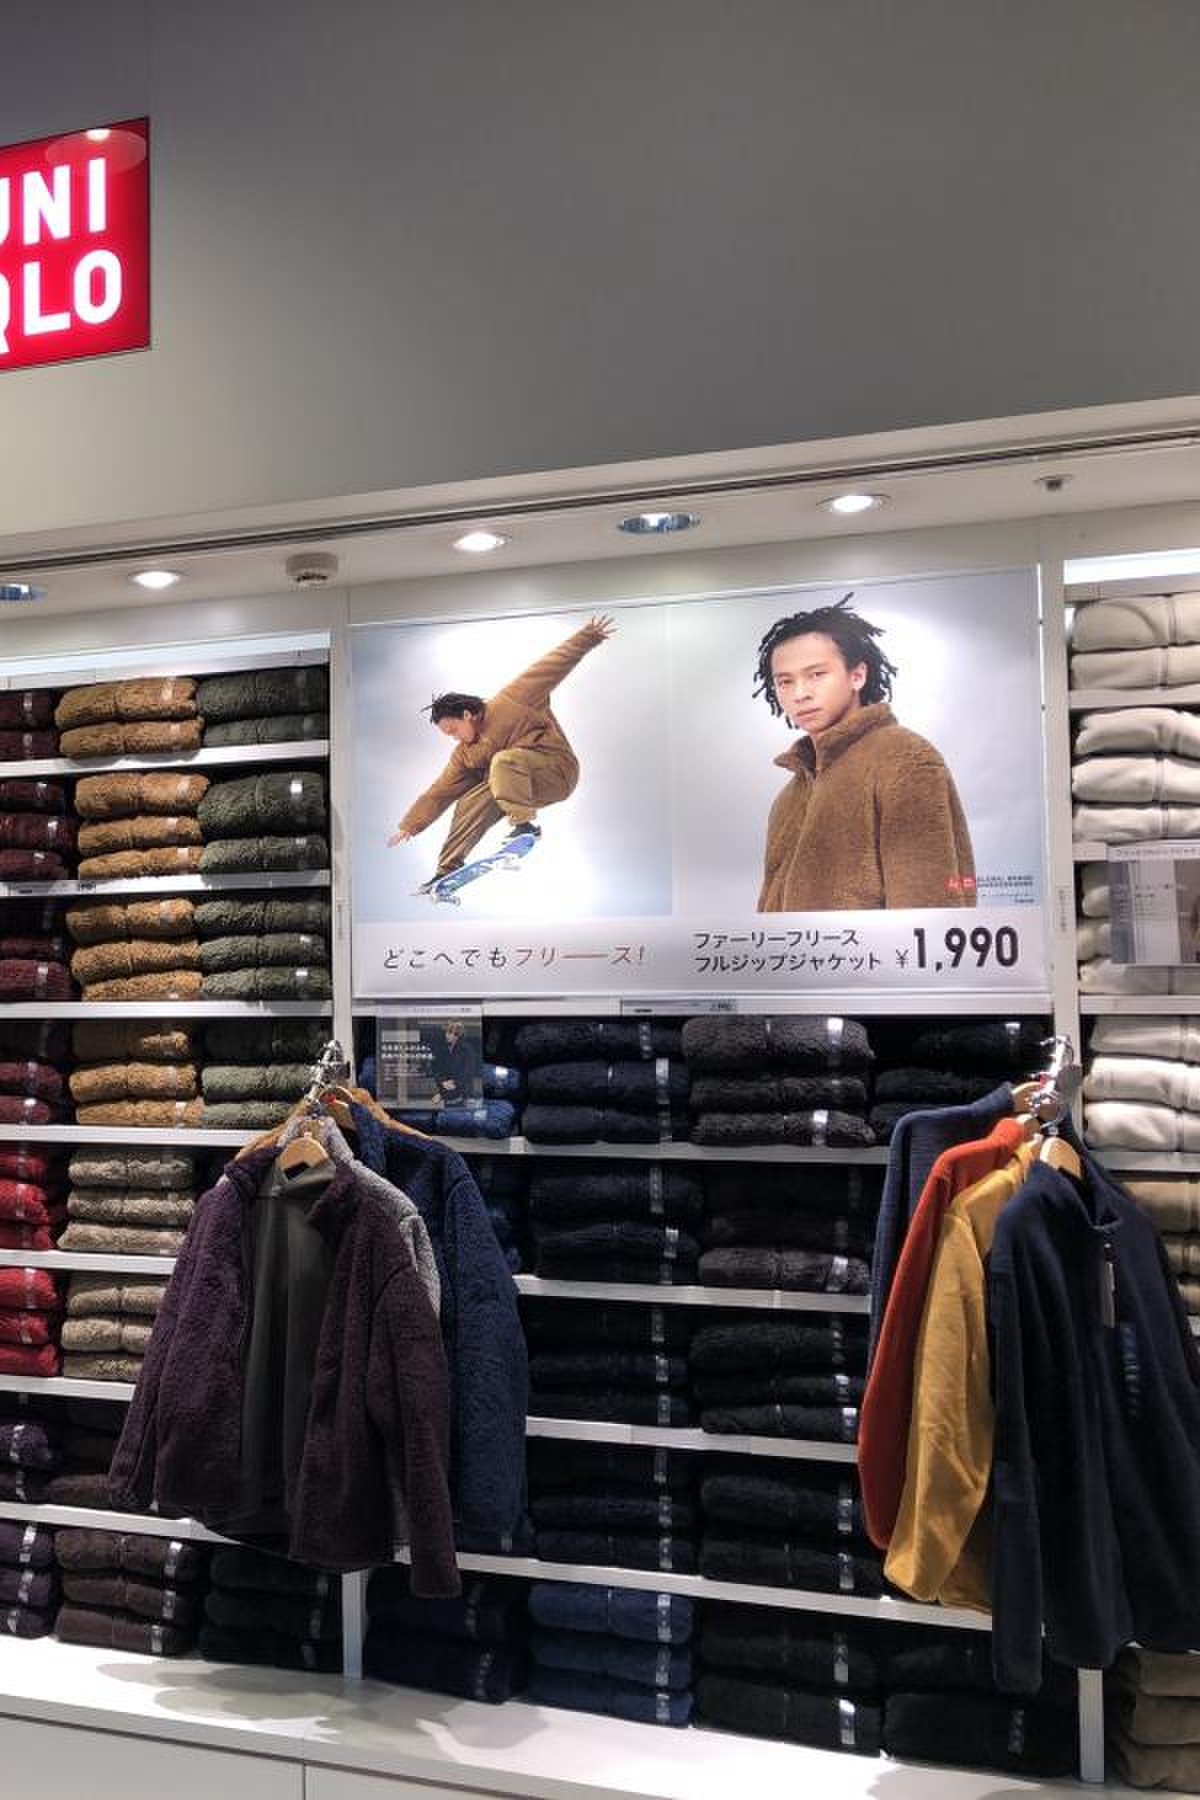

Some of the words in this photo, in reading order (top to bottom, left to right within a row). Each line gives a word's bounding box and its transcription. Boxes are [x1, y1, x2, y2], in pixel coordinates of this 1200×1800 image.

[693, 928, 860, 949] ファーリーフリース
[693, 950, 882, 973] フルジップジャケット
